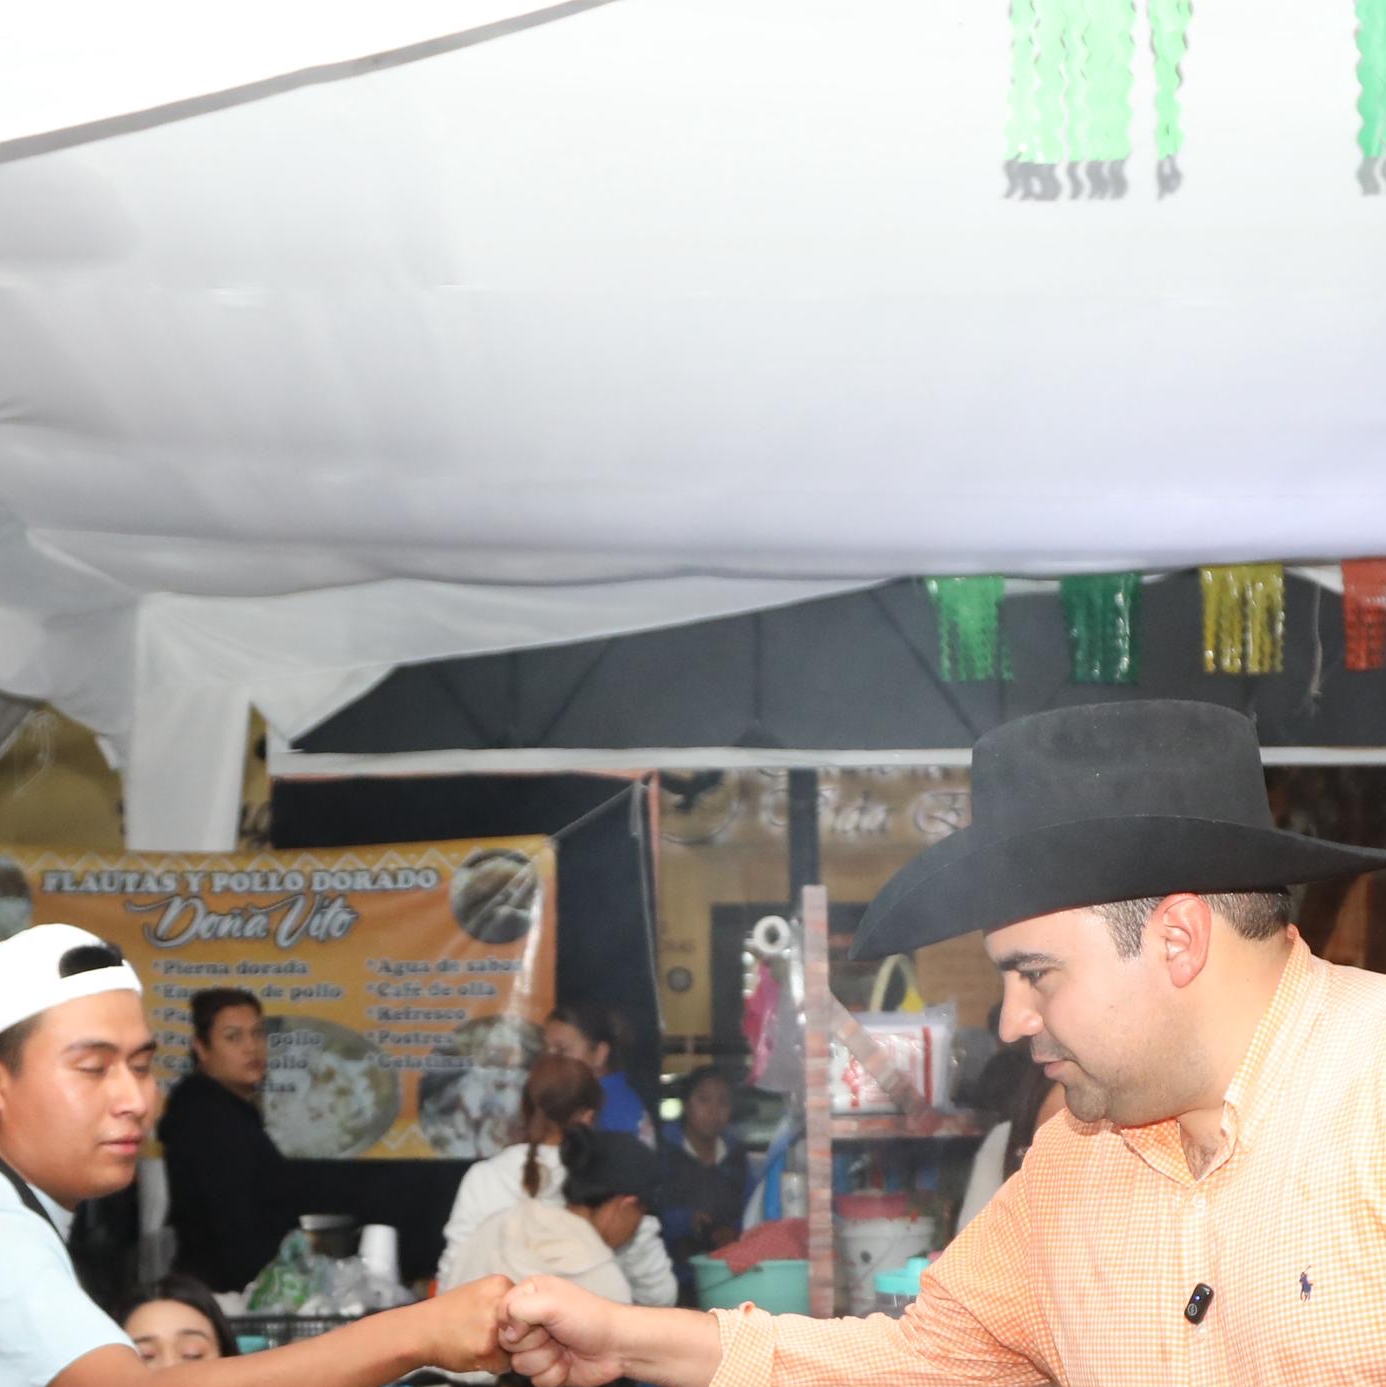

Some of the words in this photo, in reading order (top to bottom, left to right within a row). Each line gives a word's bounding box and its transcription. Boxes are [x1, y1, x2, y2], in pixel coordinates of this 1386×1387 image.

[42, 870, 177, 892] FLAUTAS
[178, 871, 209, 892] Y
[212, 871, 305, 892] POLLO
[311, 868, 439, 891] DORADO
[124, 893, 269, 949] Doña
[163, 960, 229, 976] Pierna
[235, 959, 310, 976] dorada
[377, 957, 431, 976] Agua
[288, 983, 343, 1003] pollo
[376, 1006, 466, 1022] Refresco
